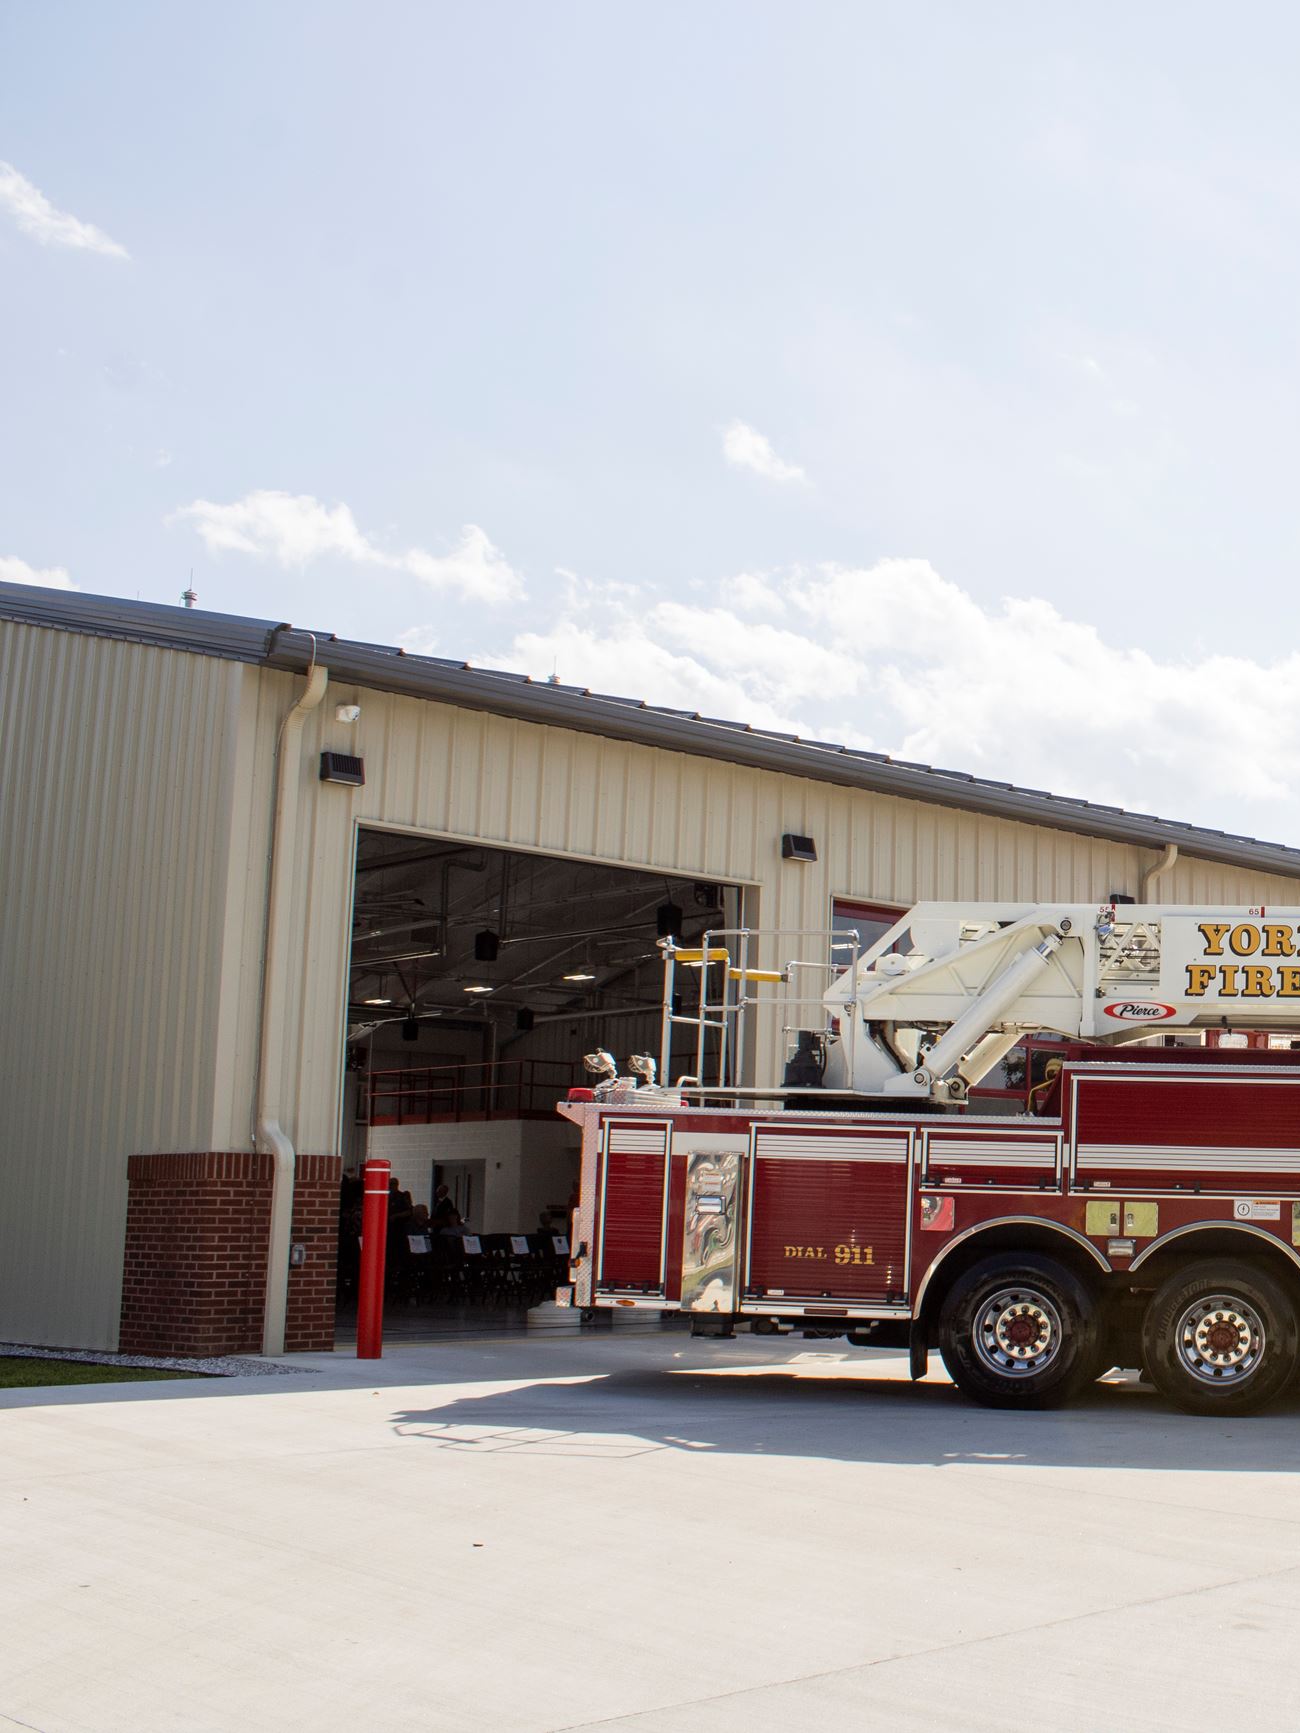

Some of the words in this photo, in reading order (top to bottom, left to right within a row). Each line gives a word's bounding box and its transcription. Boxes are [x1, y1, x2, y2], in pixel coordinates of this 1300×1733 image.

[1248, 908, 1260, 916] 65
[1119, 1004, 1160, 1016] Pierce
[784, 1246, 827, 1259] DIAL
[834, 1244, 875, 1265] 911
